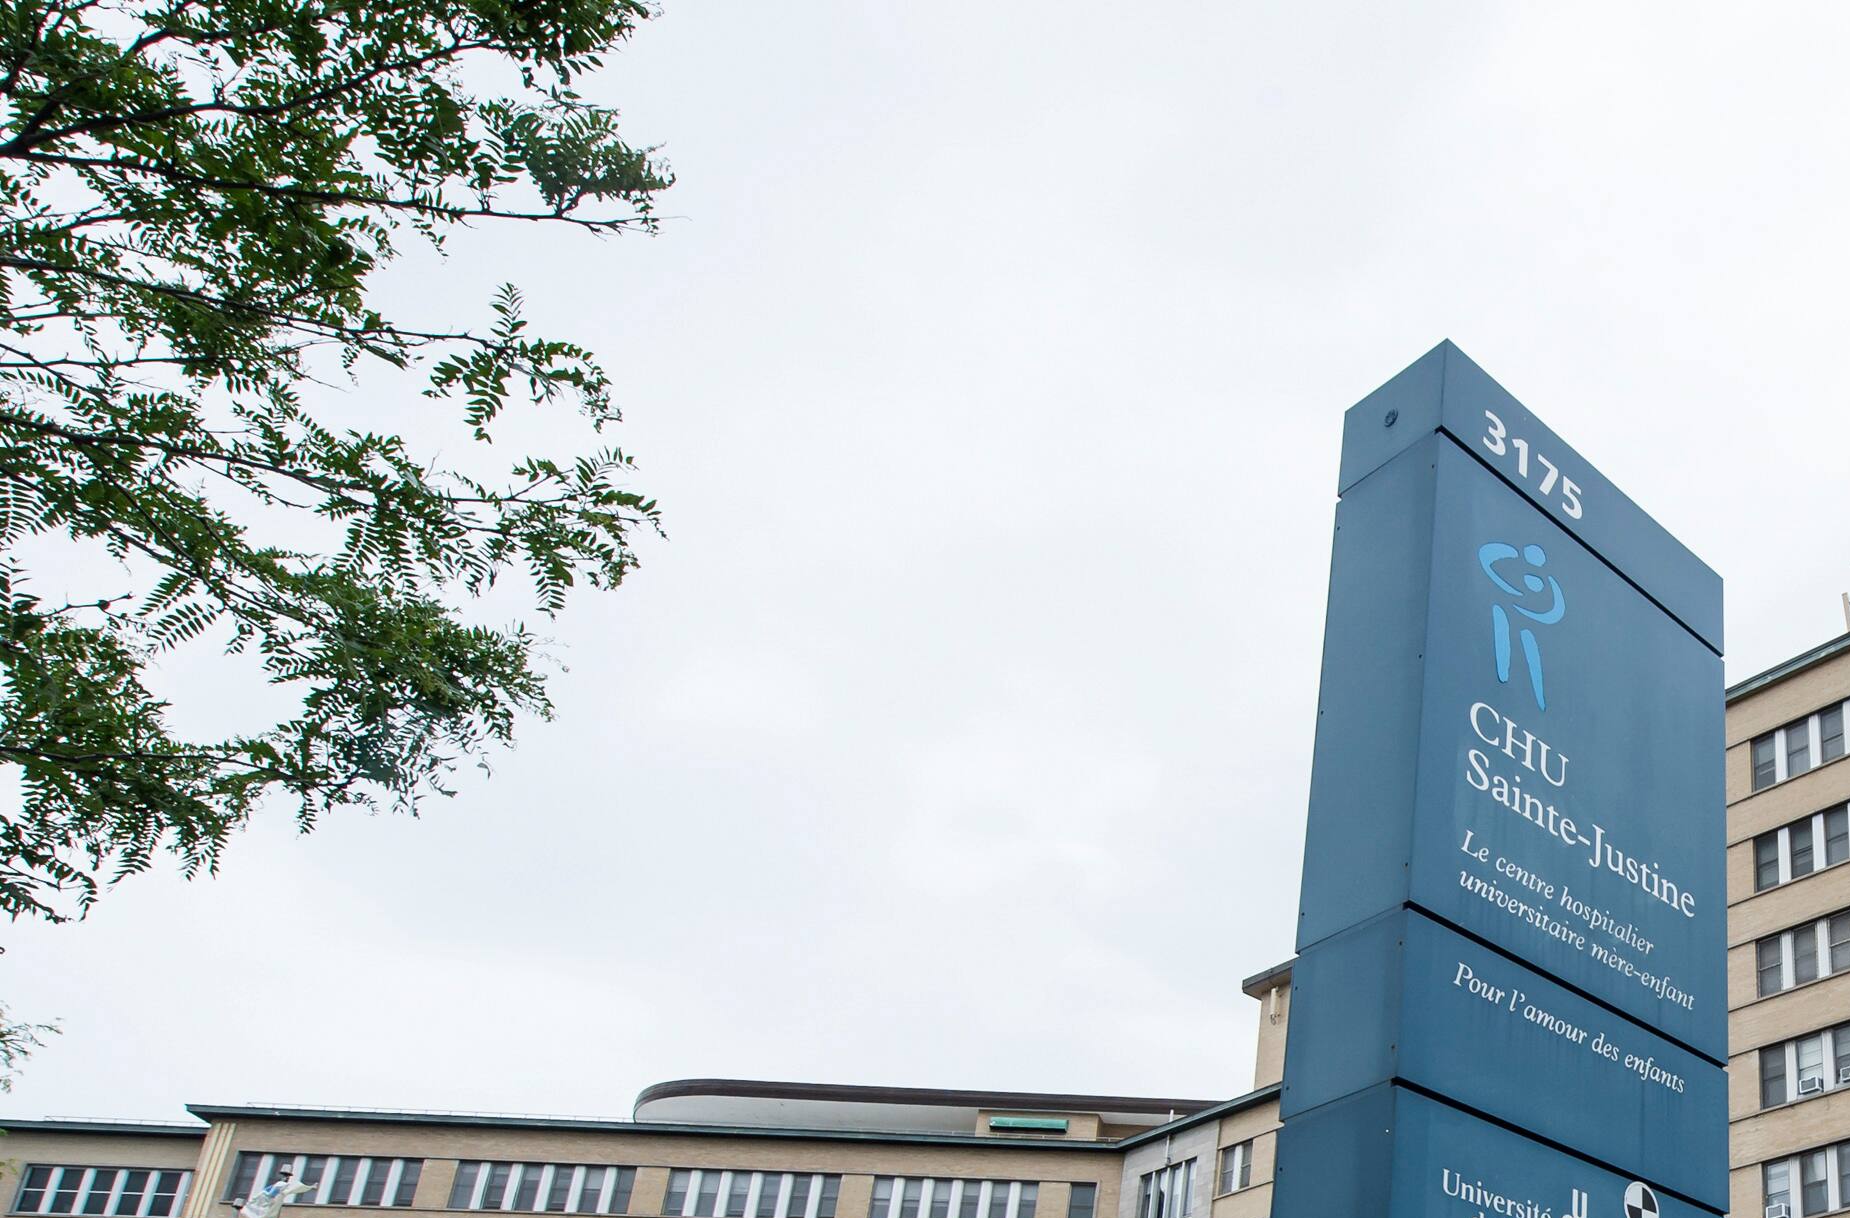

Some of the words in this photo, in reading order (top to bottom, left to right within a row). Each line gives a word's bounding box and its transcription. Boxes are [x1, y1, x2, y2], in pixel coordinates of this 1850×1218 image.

[1482, 410, 1583, 519] 3175
[1470, 702, 1569, 787] CHU
[1460, 829, 1490, 862] Le
[1495, 856, 1555, 900] centre
[1560, 886, 1654, 955] hospitalier
[1466, 749, 1696, 918] Sainte-Justine
[1459, 870, 1585, 950] universitaire
[1591, 943, 1695, 1010] mère-enfant
[1453, 962, 1505, 1006] Pour
[1508, 989, 1588, 1045] l'amour
[1591, 1032, 1620, 1062] des
[1624, 1055, 1685, 1094] enfants
